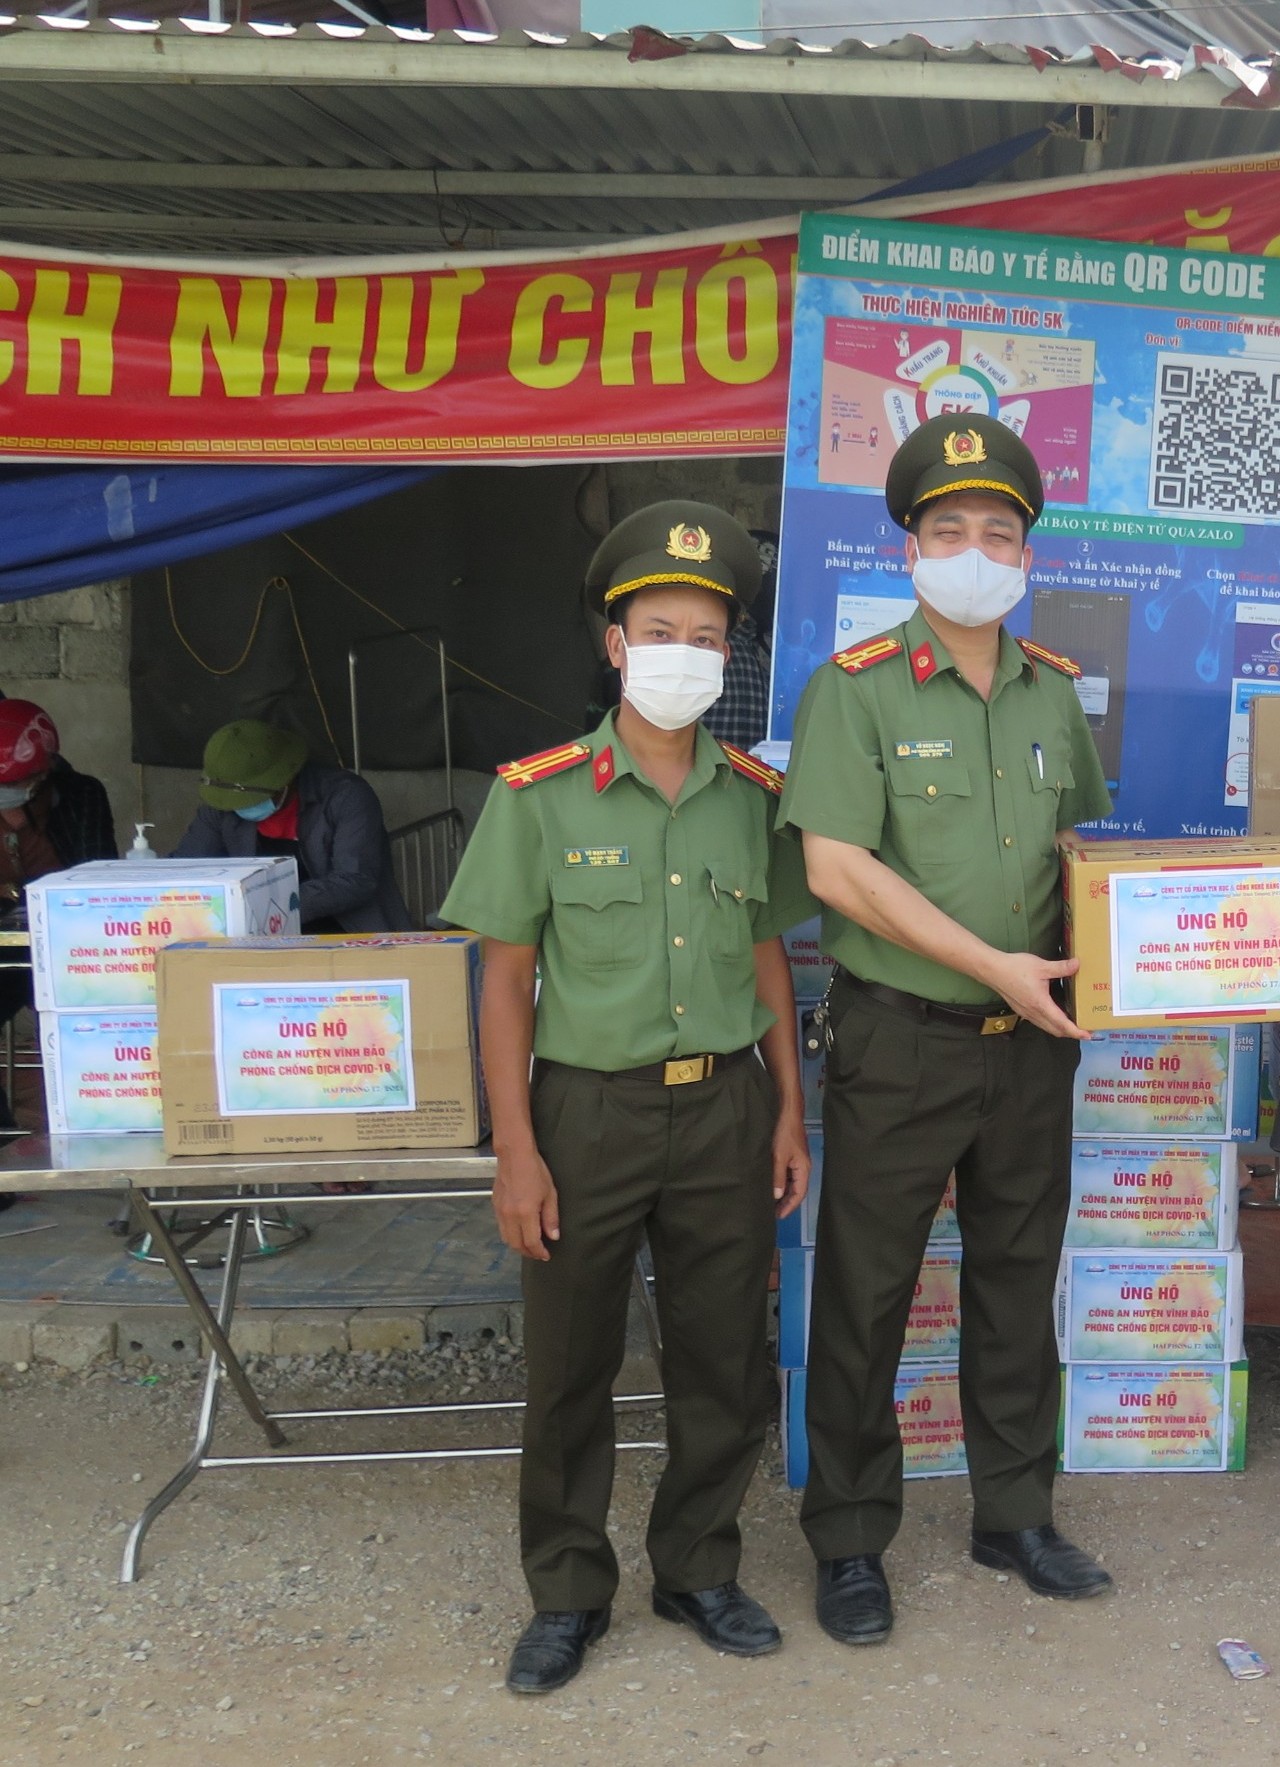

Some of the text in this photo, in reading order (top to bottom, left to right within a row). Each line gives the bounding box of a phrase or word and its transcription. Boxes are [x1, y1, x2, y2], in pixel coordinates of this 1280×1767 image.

[822, 229, 1266, 300] ĐIỂM KHAI BÁO Y TẾ BẰNG QR CODE
[862, 294, 1063, 329] THỰC HIỆN NGHIÊM TÚC 5K
[0, 268, 122, 396] H
[168, 265, 485, 397] NHƯ
[1176, 316, 1223, 332] QR-CODE
[1227, 318, 1254, 335] ĐIỂM
[934, 389, 963, 399] THÔNG
[881, 524, 886, 536] 1
[1052, 515, 1079, 529] BÁO
[1081, 520, 1091, 531] Y
[1093, 518, 1110, 532] TẾ
[1113, 521, 1145, 536] ĐIỆN
[1147, 523, 1166, 535] TỬ
[1168, 526, 1195, 539] QUA
[1198, 529, 1234, 541] ZALO
[827, 538, 853, 553] Bấm
[856, 543, 876, 554] nút
[1082, 543, 1089, 552] 2
[825, 556, 851, 569] phải
[852, 558, 873, 572] góc
[875, 560, 898, 572] trên
[1069, 559, 1082, 570] và
[1101, 561, 1122, 573] Xác
[1125, 562, 1152, 577] nhận
[1155, 563, 1182, 579] đồng
[1030, 570, 1160, 592] chuyển sang tờ khai y tế
[1206, 568, 1236, 583] Chọn
[1219, 582, 1233, 596] để
[1235, 585, 1259, 597] khai
[1262, 586, 1280, 599] báo
[1101, 819, 1121, 830] báo
[1123, 823, 1131, 833] y
[1181, 821, 1237, 837] Xuất trình
[148, 917, 173, 939] HỘ
[1177, 907, 1248, 932] ỦNG HỘ
[70, 946, 100, 958] CÔNG
[103, 947, 118, 957] AN
[1139, 941, 1171, 955] CÔNG
[1174, 942, 1190, 953] AN
[1193, 939, 1231, 954] HUYỆN
[1233, 937, 1260, 950] VĨNH
[1136, 960, 1172, 974] PHÒNG
[1175, 957, 1212, 972] CHỐNG
[1214, 958, 1240, 972] DỊCH
[279, 1016, 348, 1041] ỦNG HỘ
[243, 1048, 274, 1060] CÔNG
[276, 1049, 292, 1059] AN
[363, 1044, 386, 1057] BẢO
[278, 1063, 314, 1076] CHỐNG
[317, 1064, 341, 1077] DỊCH
[343, 1062, 392, 1074] COVID-19
[1121, 1050, 1181, 1074] ỦNG HỘ
[1088, 1077, 1114, 1088] CÔNG
[1117, 1079, 1130, 1089] AN
[1191, 1078, 1211, 1091] BẢO
[1117, 1091, 1148, 1104] CHỐNG
[1150, 1095, 1171, 1107] DỊCH
[1173, 1095, 1215, 1106] COVID-19
[1120, 1281, 1180, 1304] ỦNG HỘ
[1088, 1307, 1114, 1318] CÔNG
[1117, 1308, 1131, 1318] AN
[1190, 1306, 1210, 1318] BẢO
[1149, 1323, 1170, 1335] DỊCH
[1172, 1323, 1213, 1333] COVID-19
[911, 1396, 932, 1415] HỘ
